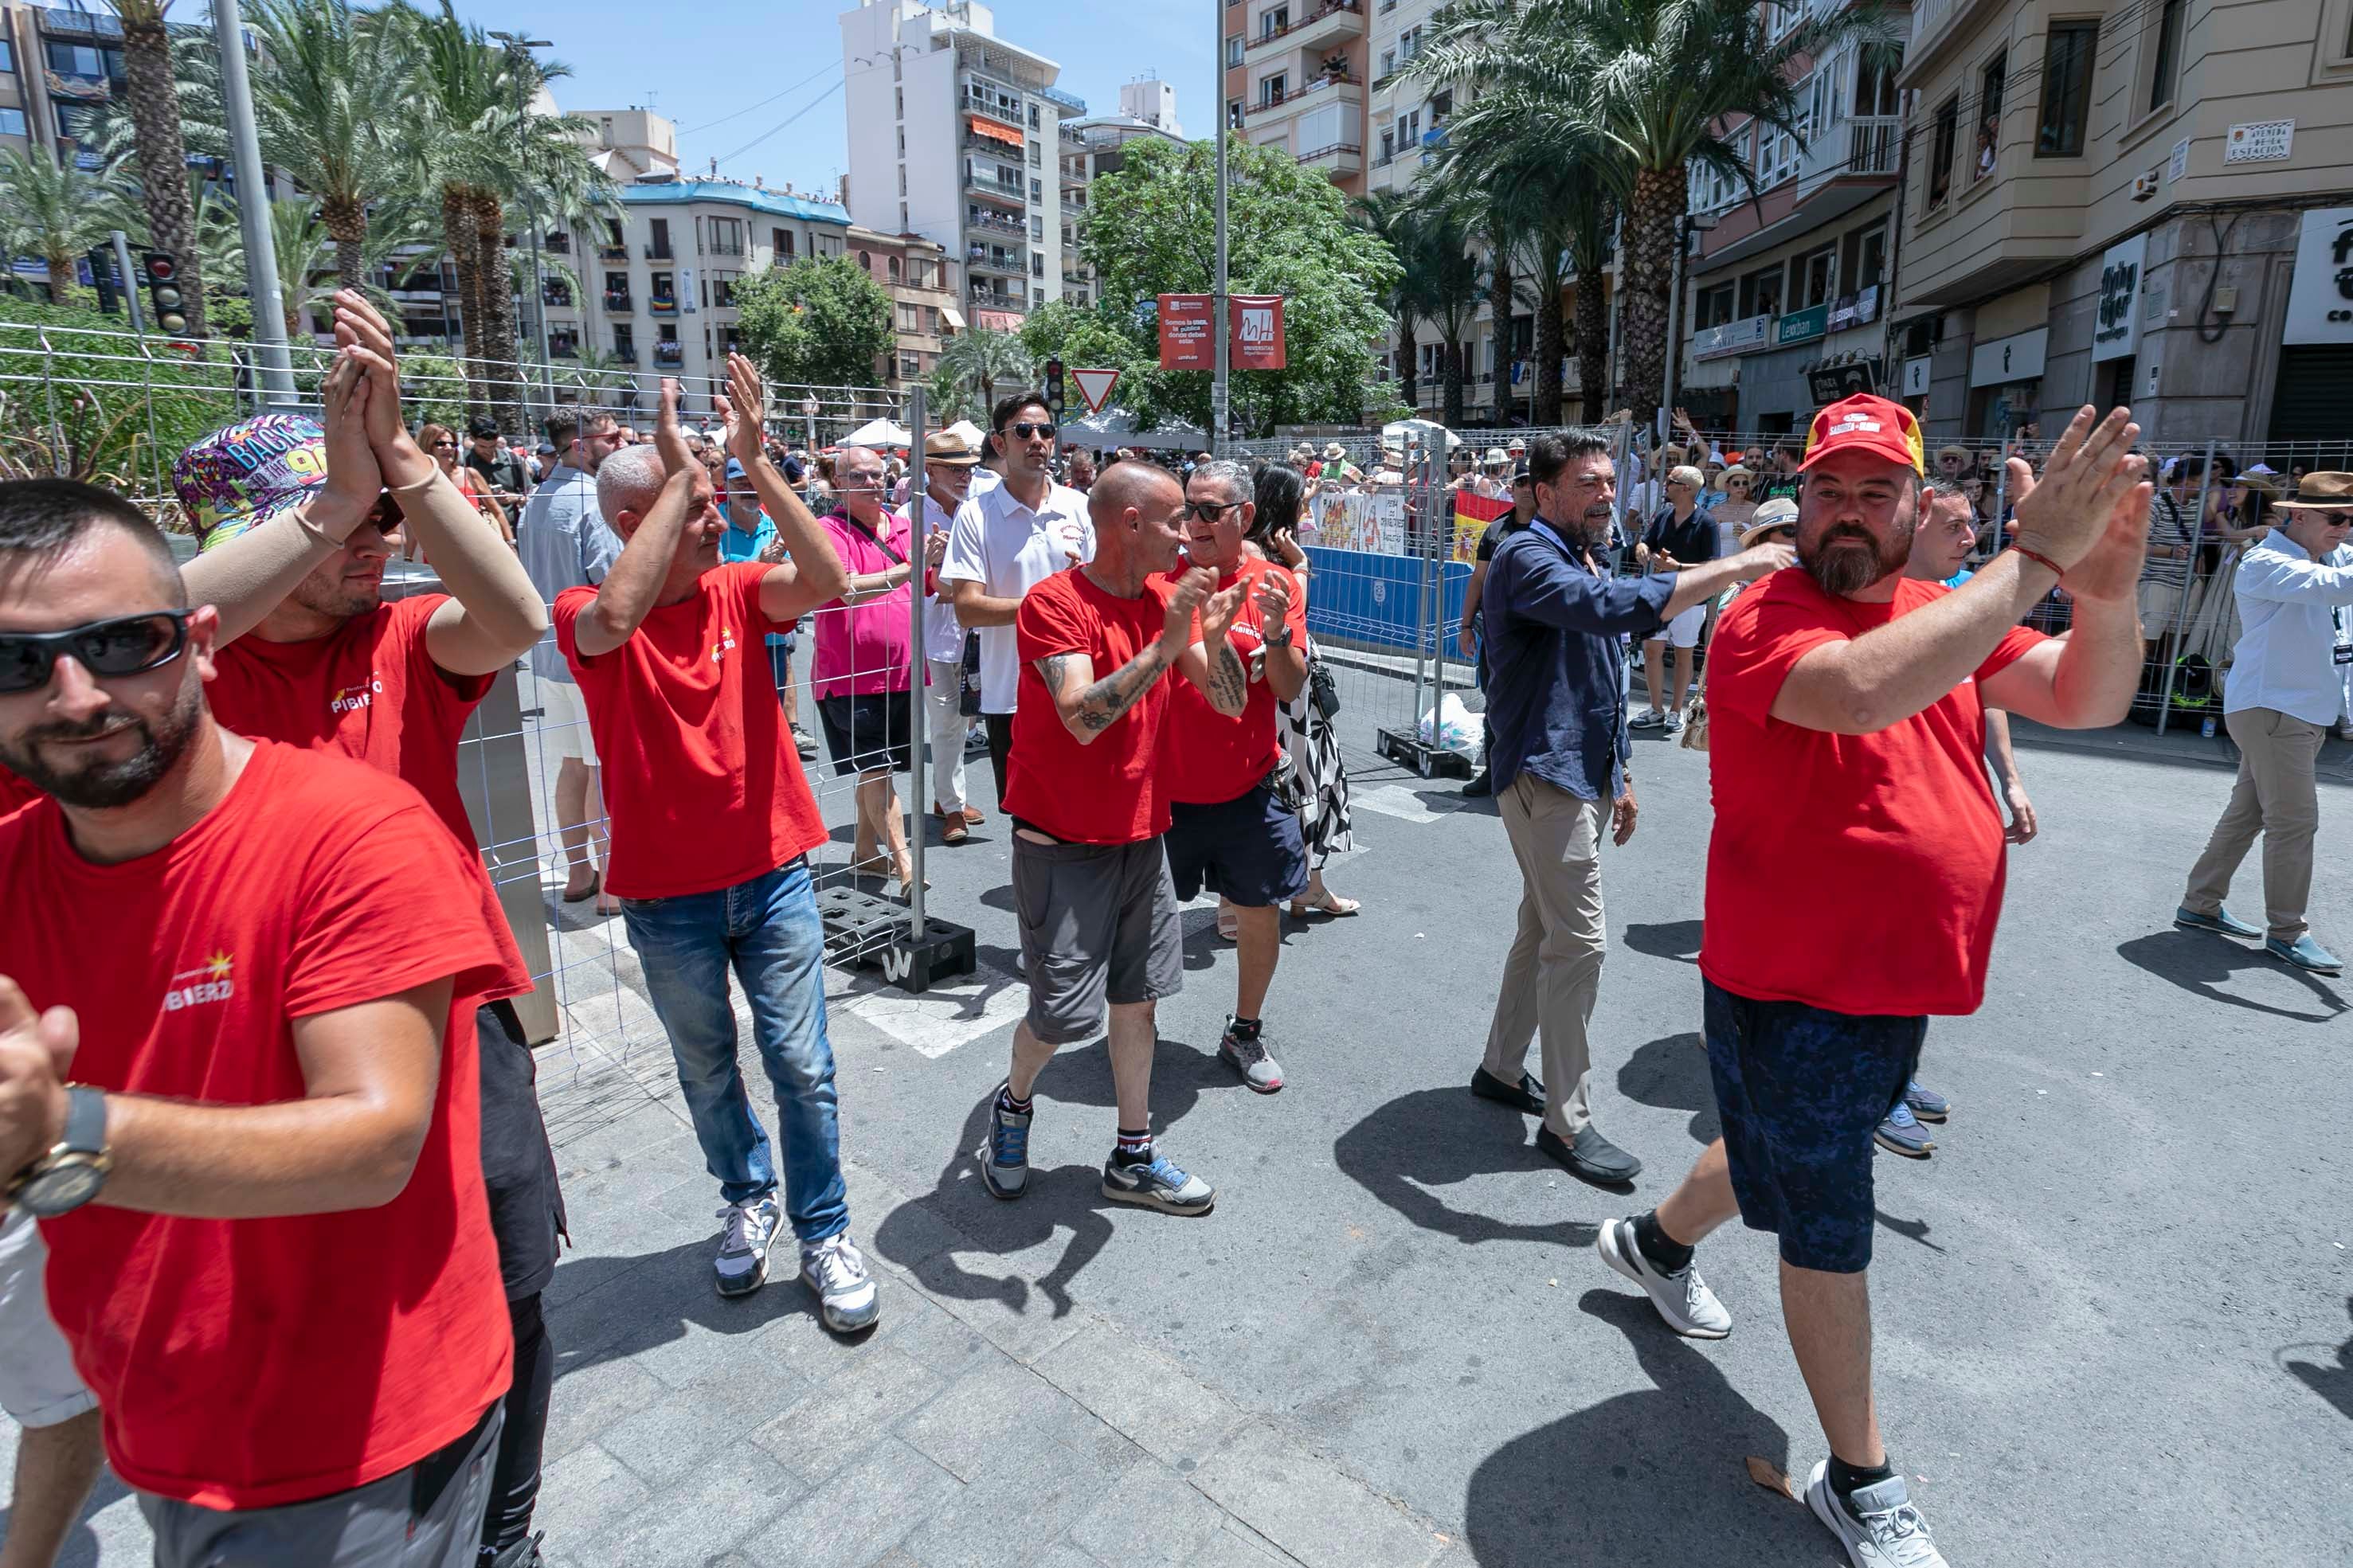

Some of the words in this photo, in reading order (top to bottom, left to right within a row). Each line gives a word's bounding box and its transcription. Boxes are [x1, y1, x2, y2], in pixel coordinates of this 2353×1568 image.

[2251, 128, 2286, 138] AVENIDA
[1782, 319, 1810, 339] Lexxban
[227, 424, 304, 471] BACK
[266, 459, 292, 479] THE
[881, 947, 912, 983] W
